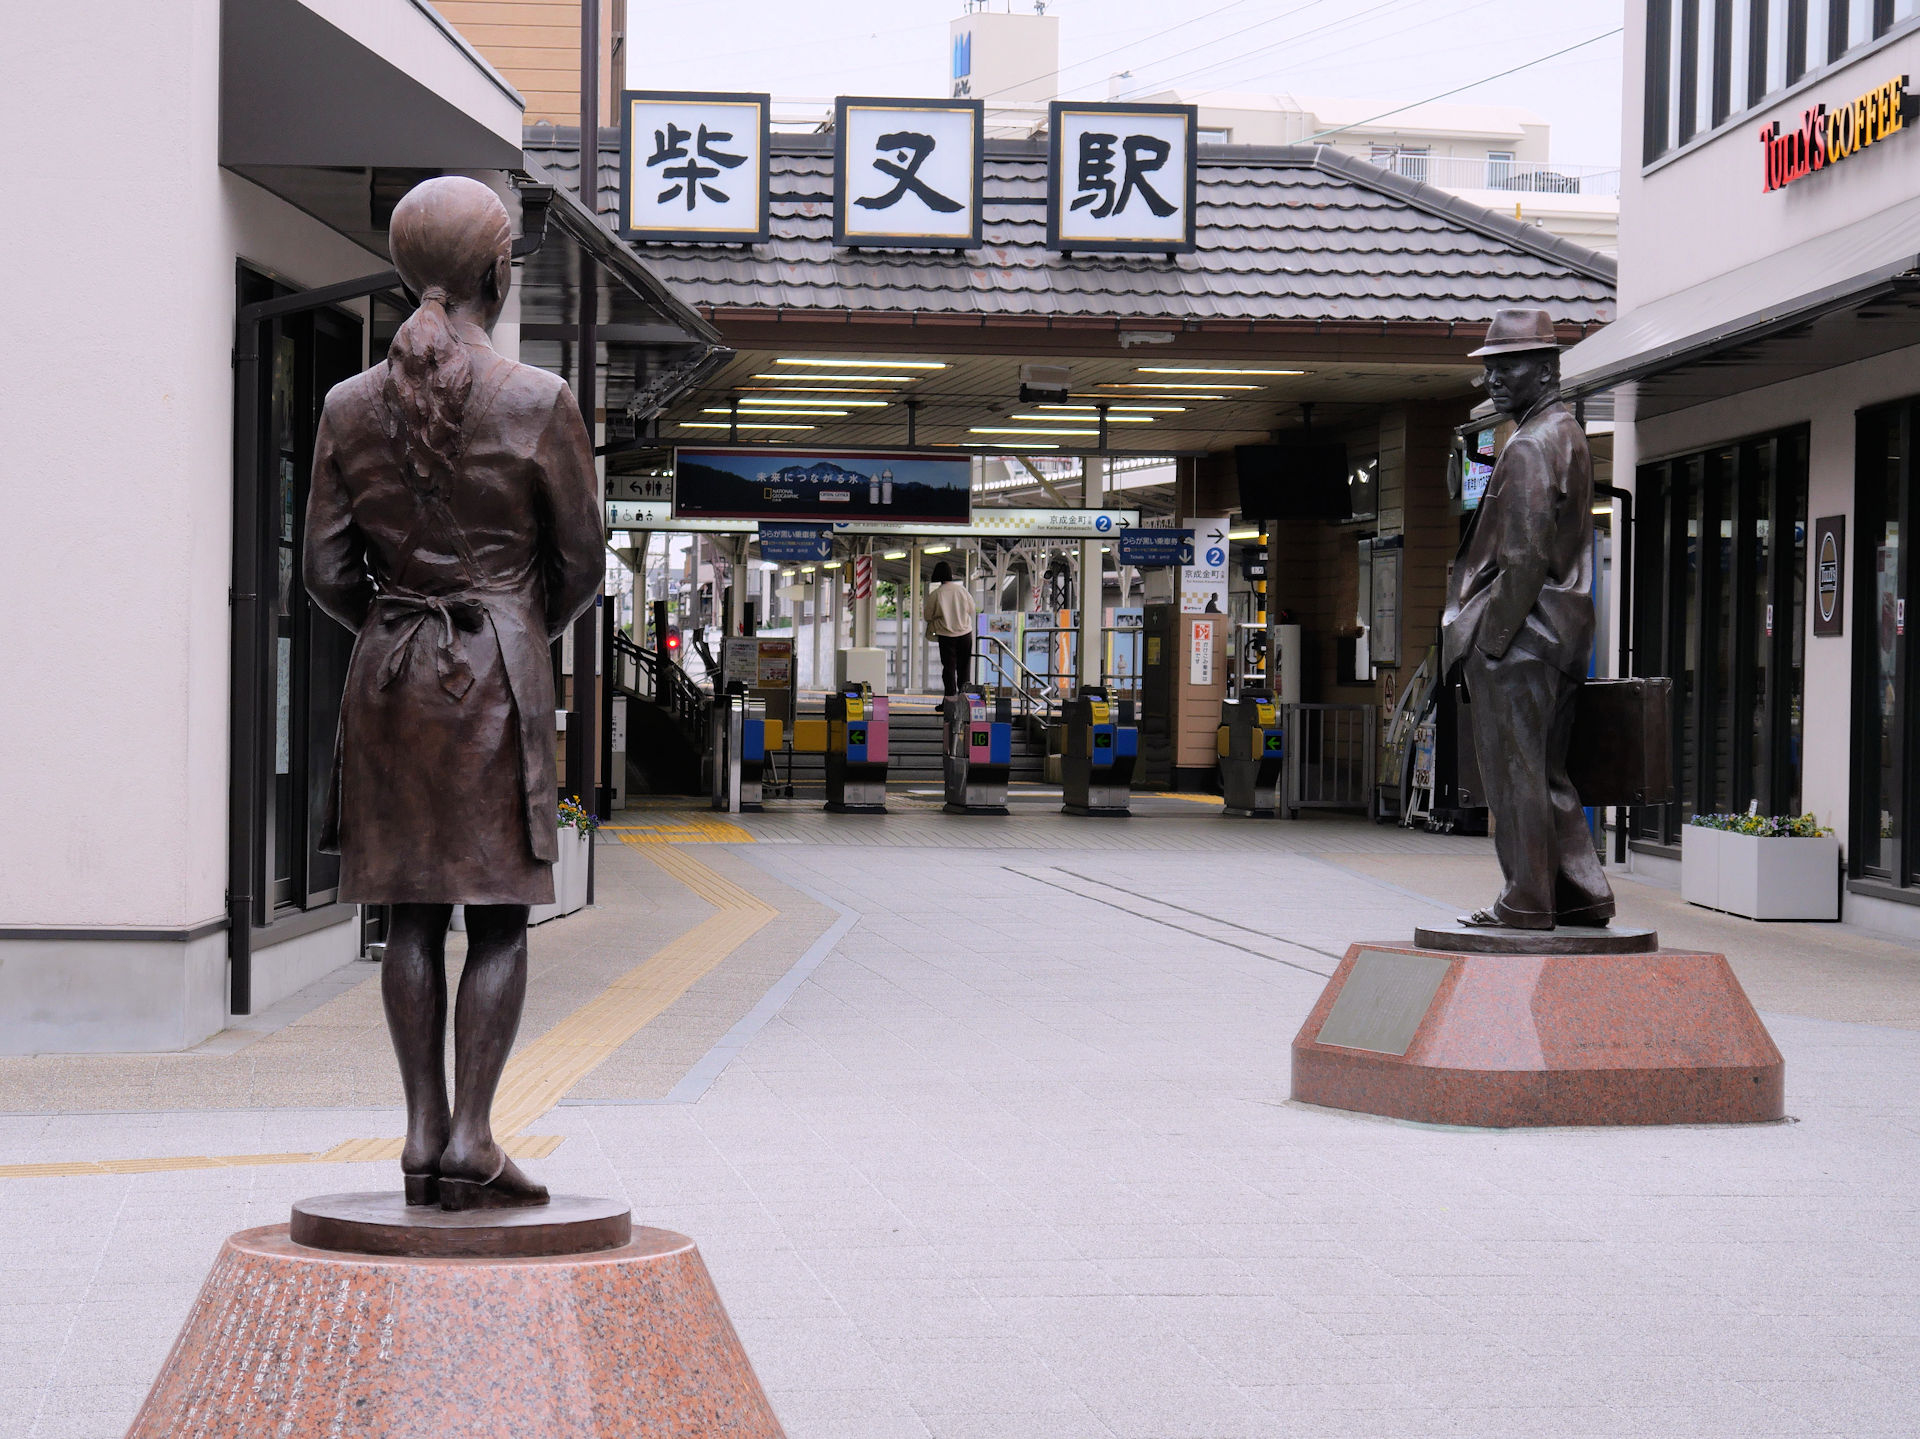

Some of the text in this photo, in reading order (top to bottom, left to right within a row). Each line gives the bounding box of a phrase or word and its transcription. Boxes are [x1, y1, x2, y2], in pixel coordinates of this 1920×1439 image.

[1759, 74, 1906, 194] TULLY'S COFFEE
[756, 472, 859, 485] 未来につながる水
[1049, 515, 1087, 526] 京成金町
[1099, 518, 1109, 531] 2
[1209, 549, 1221, 565] 2
[1184, 569, 1219, 579] 京成金町
[973, 732, 986, 746] IC
